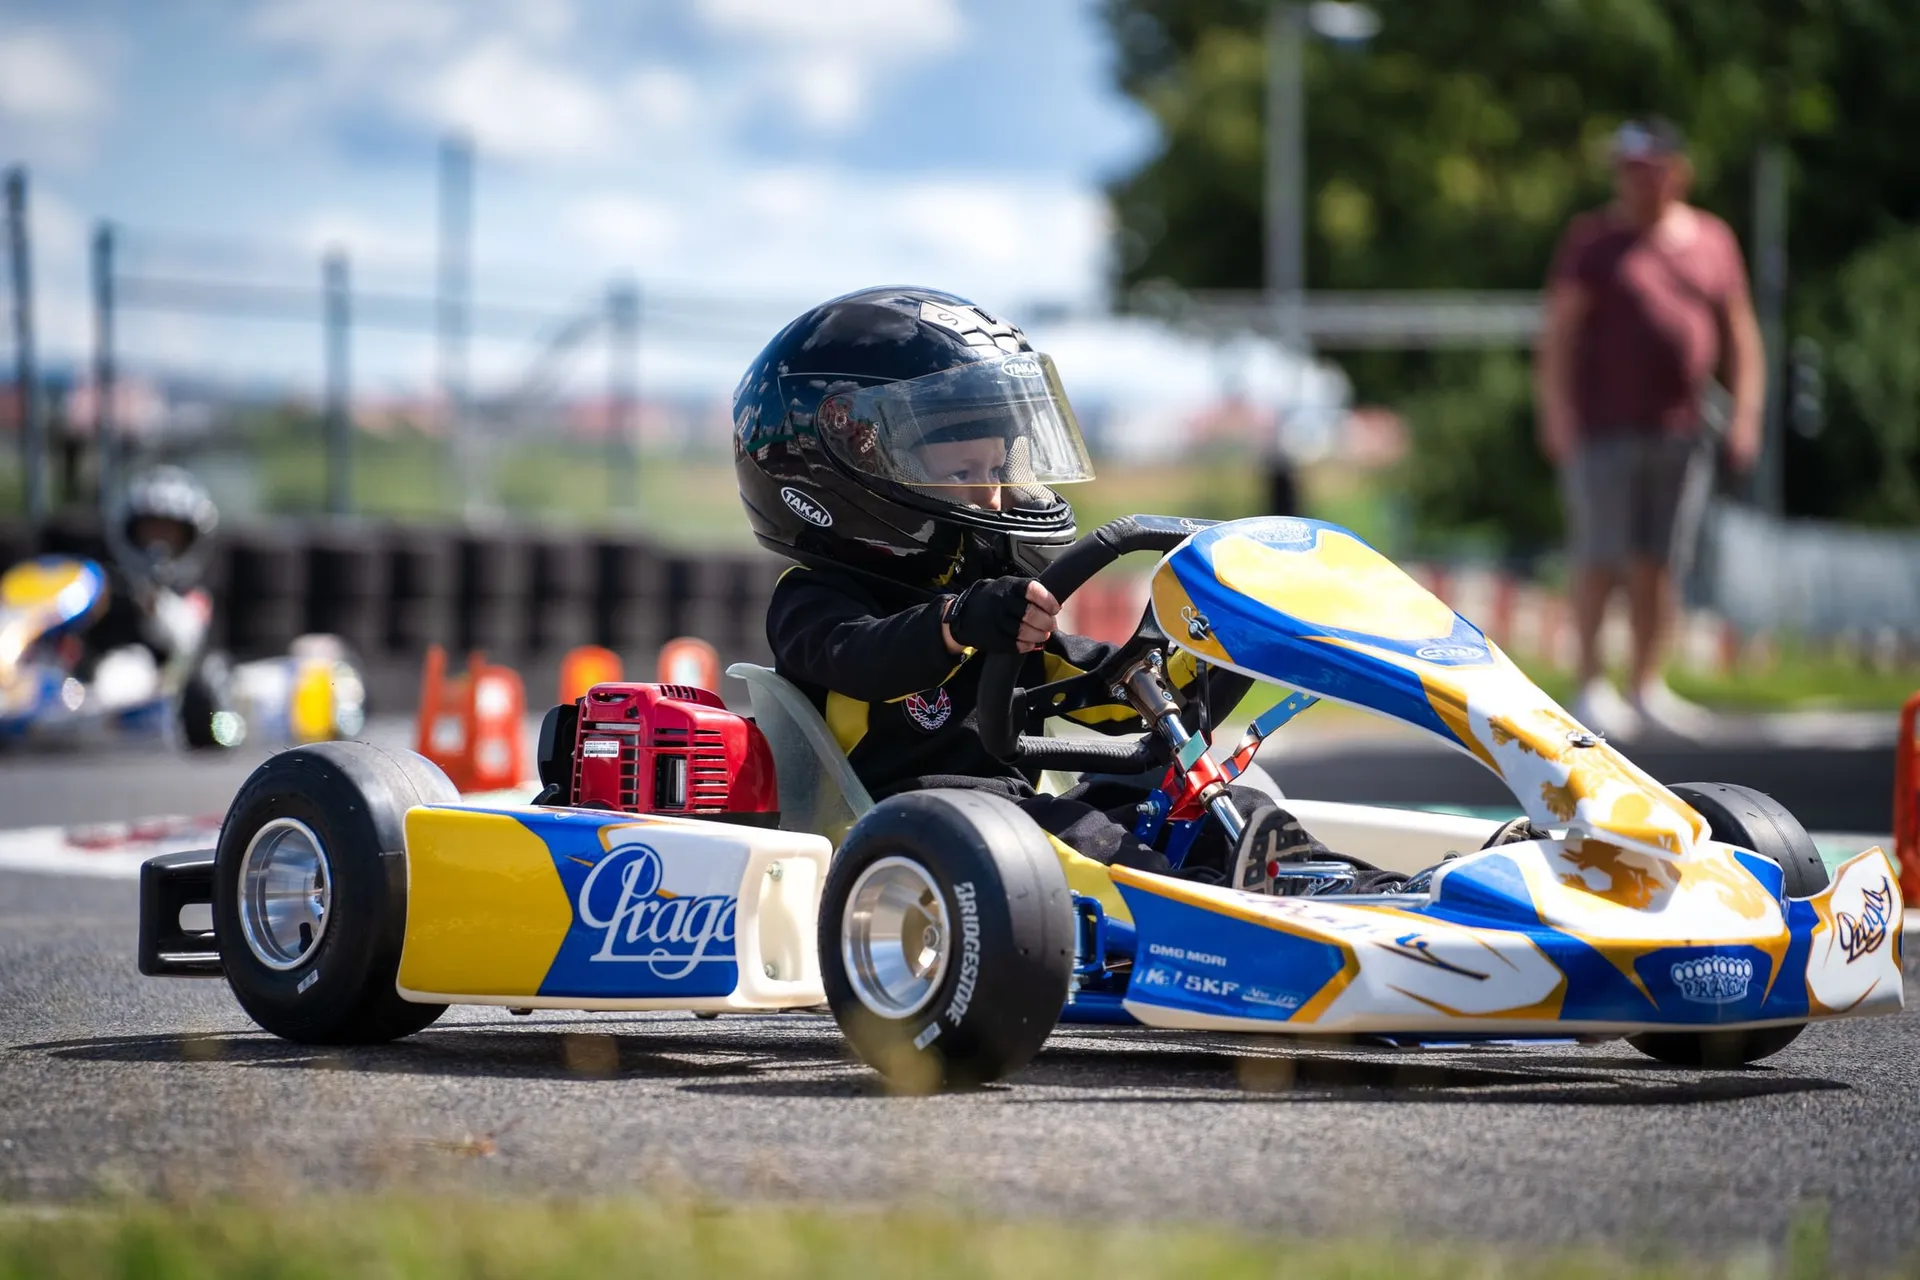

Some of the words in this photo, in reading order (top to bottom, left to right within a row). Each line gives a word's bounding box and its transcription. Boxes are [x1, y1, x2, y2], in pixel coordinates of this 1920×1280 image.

[785, 490, 828, 525] TAKAI
[945, 881, 981, 1028] BRIDGESTONE
[1149, 943, 1185, 959] DMG
[1186, 950, 1228, 967] MORI
[1184, 975, 1240, 996] SKF
